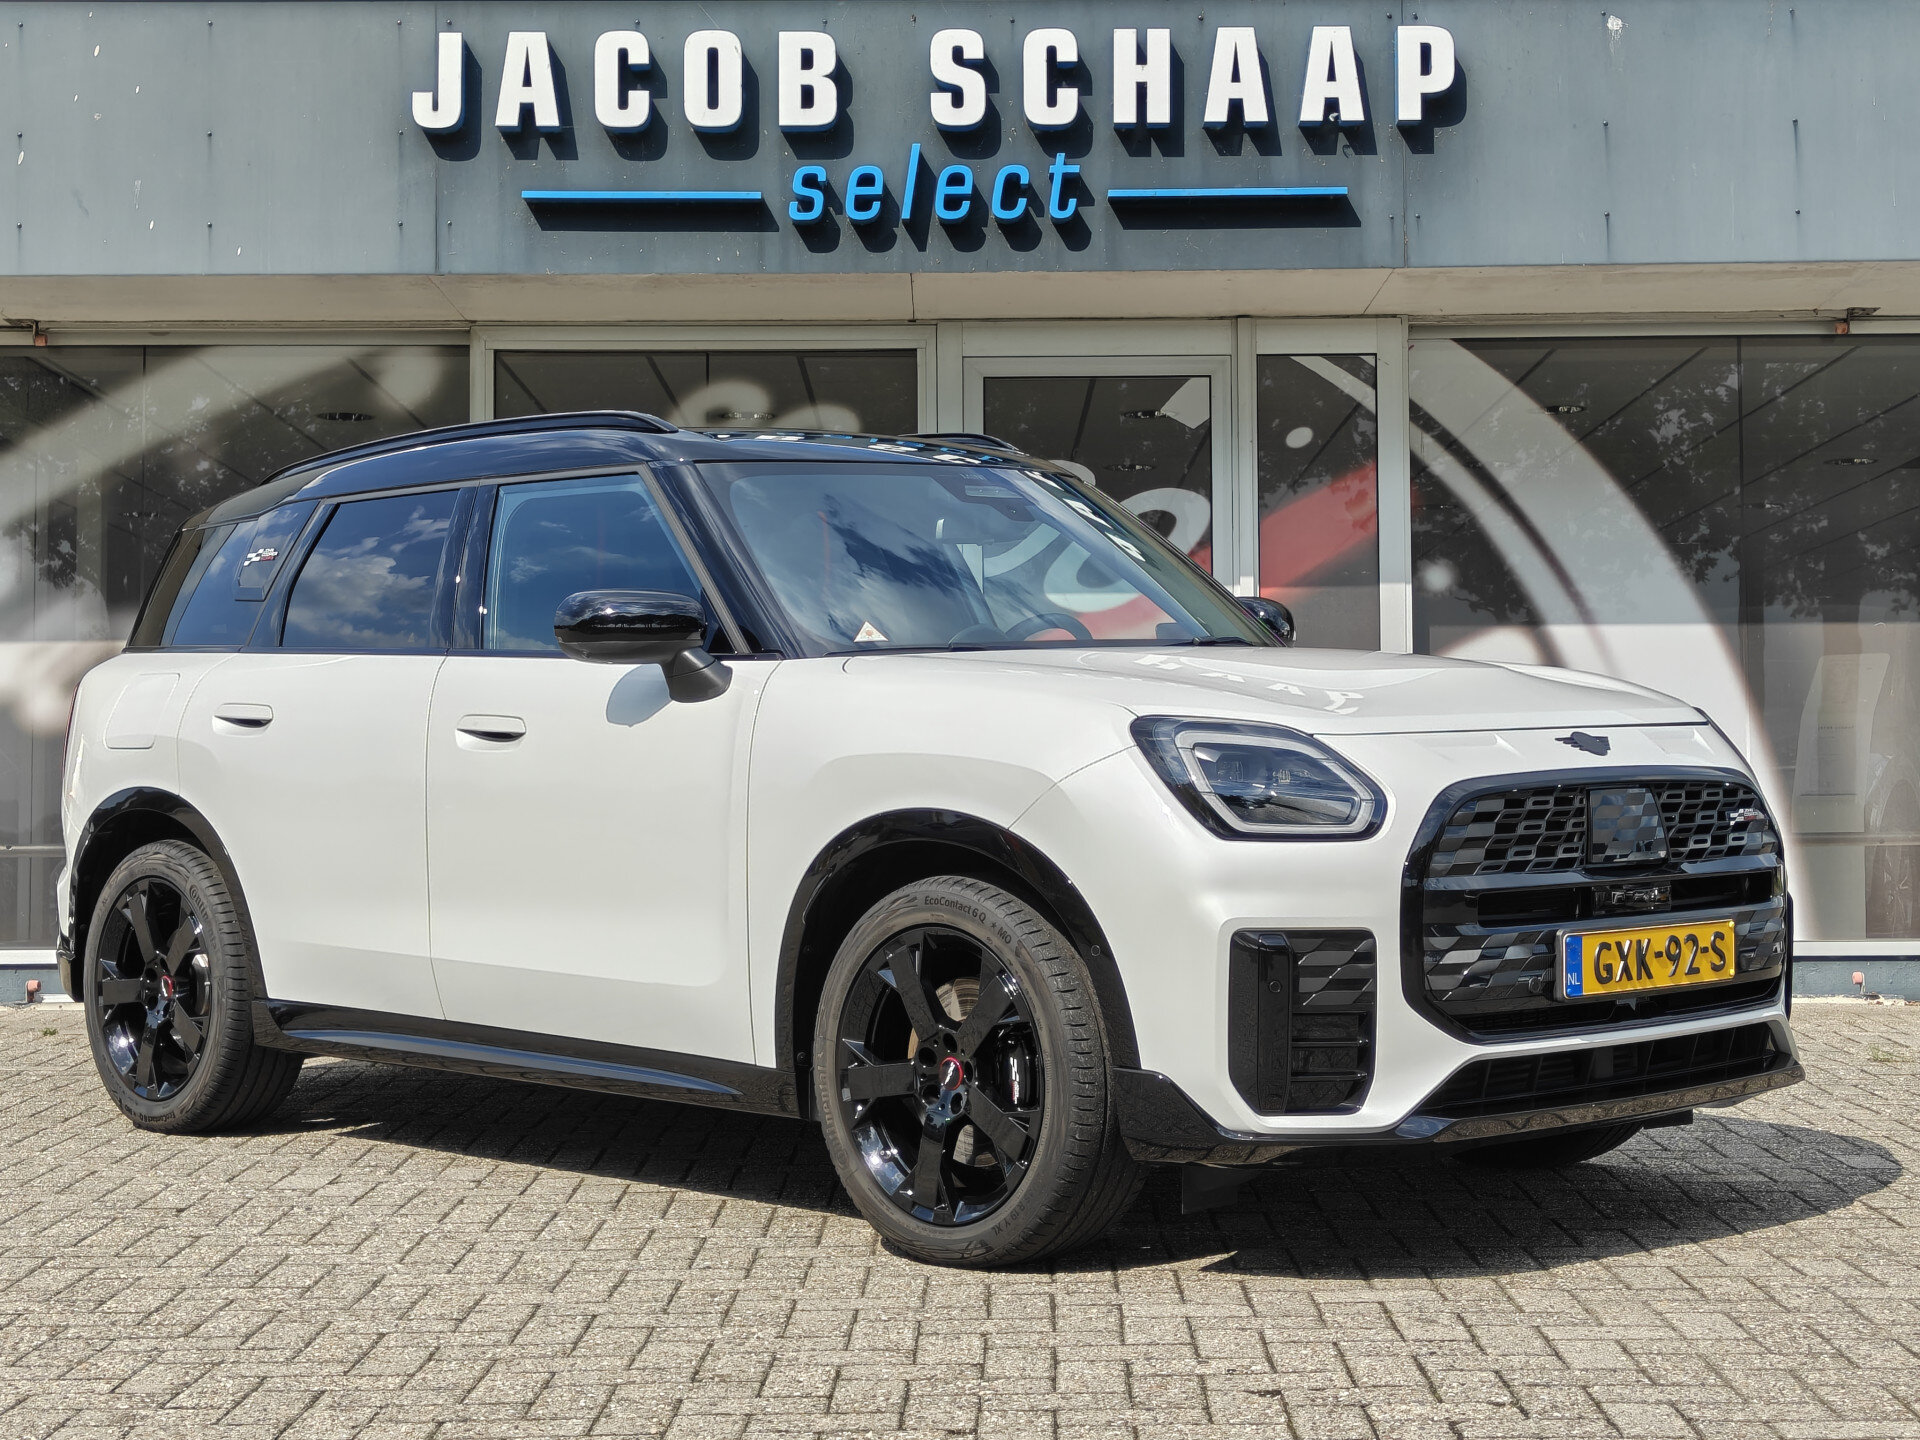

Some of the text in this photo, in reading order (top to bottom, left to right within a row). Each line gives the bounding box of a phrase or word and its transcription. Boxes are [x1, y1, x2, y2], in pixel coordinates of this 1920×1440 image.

[411, 25, 1456, 131] JACOB SCHAAP
[788, 142, 1081, 223] select
[924, 895, 972, 915] EcoContact
[972, 908, 979, 918] 6
[979, 912, 987, 924] Q
[1567, 972, 1581, 986] NL
[1593, 930, 1727, 985] GXK-92-S
